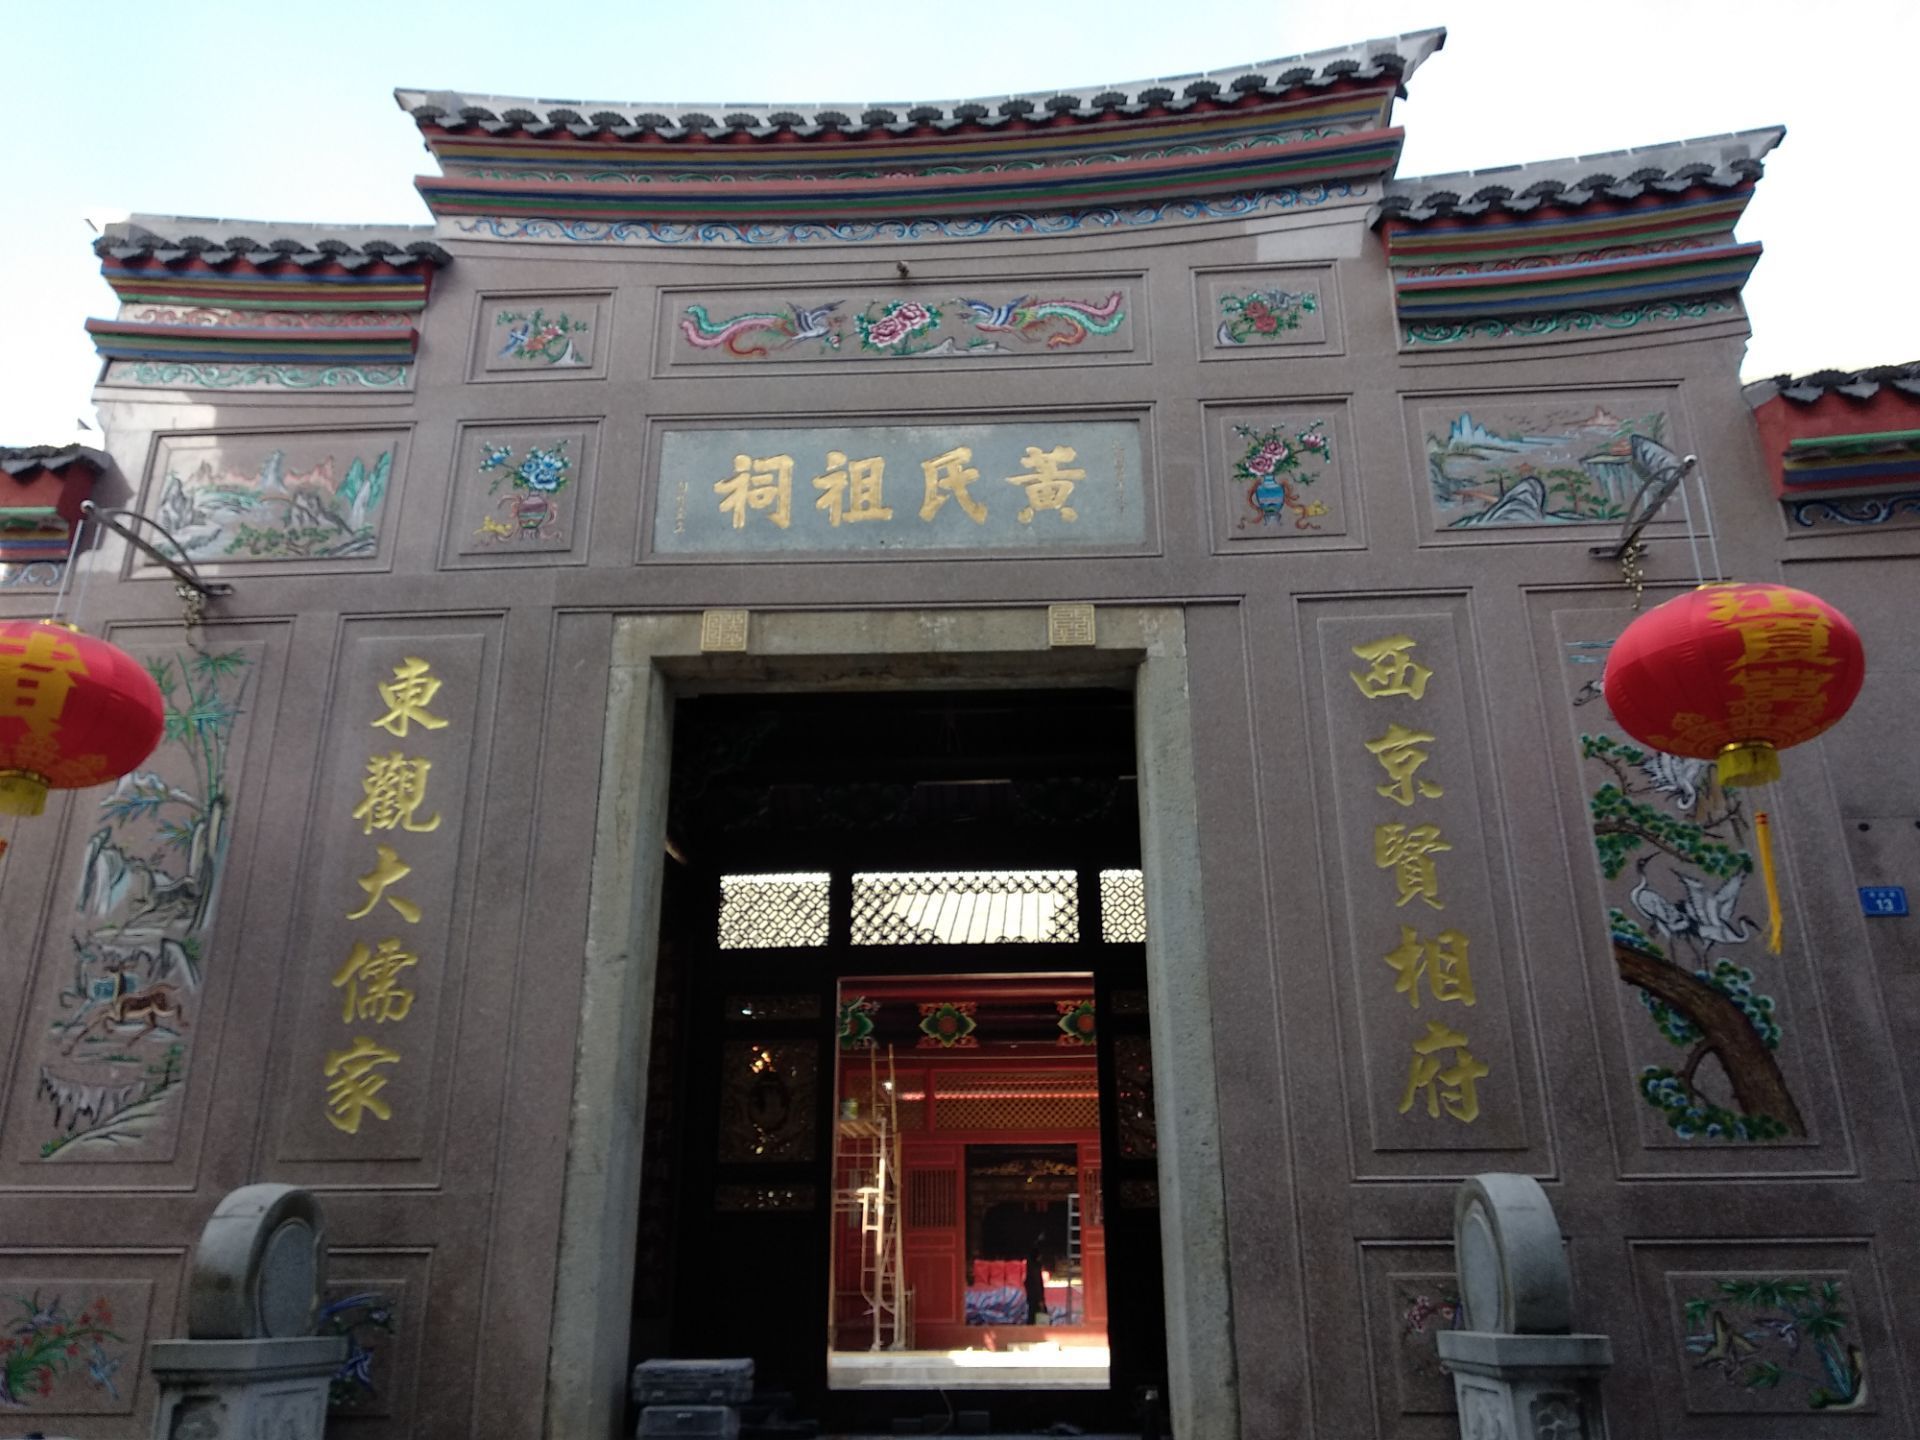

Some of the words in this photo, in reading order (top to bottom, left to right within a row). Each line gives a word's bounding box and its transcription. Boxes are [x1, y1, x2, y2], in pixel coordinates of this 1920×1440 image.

[324, 657, 449, 1135] 東觀大儒家
[1351, 636, 1489, 1123] 西京賢相府
